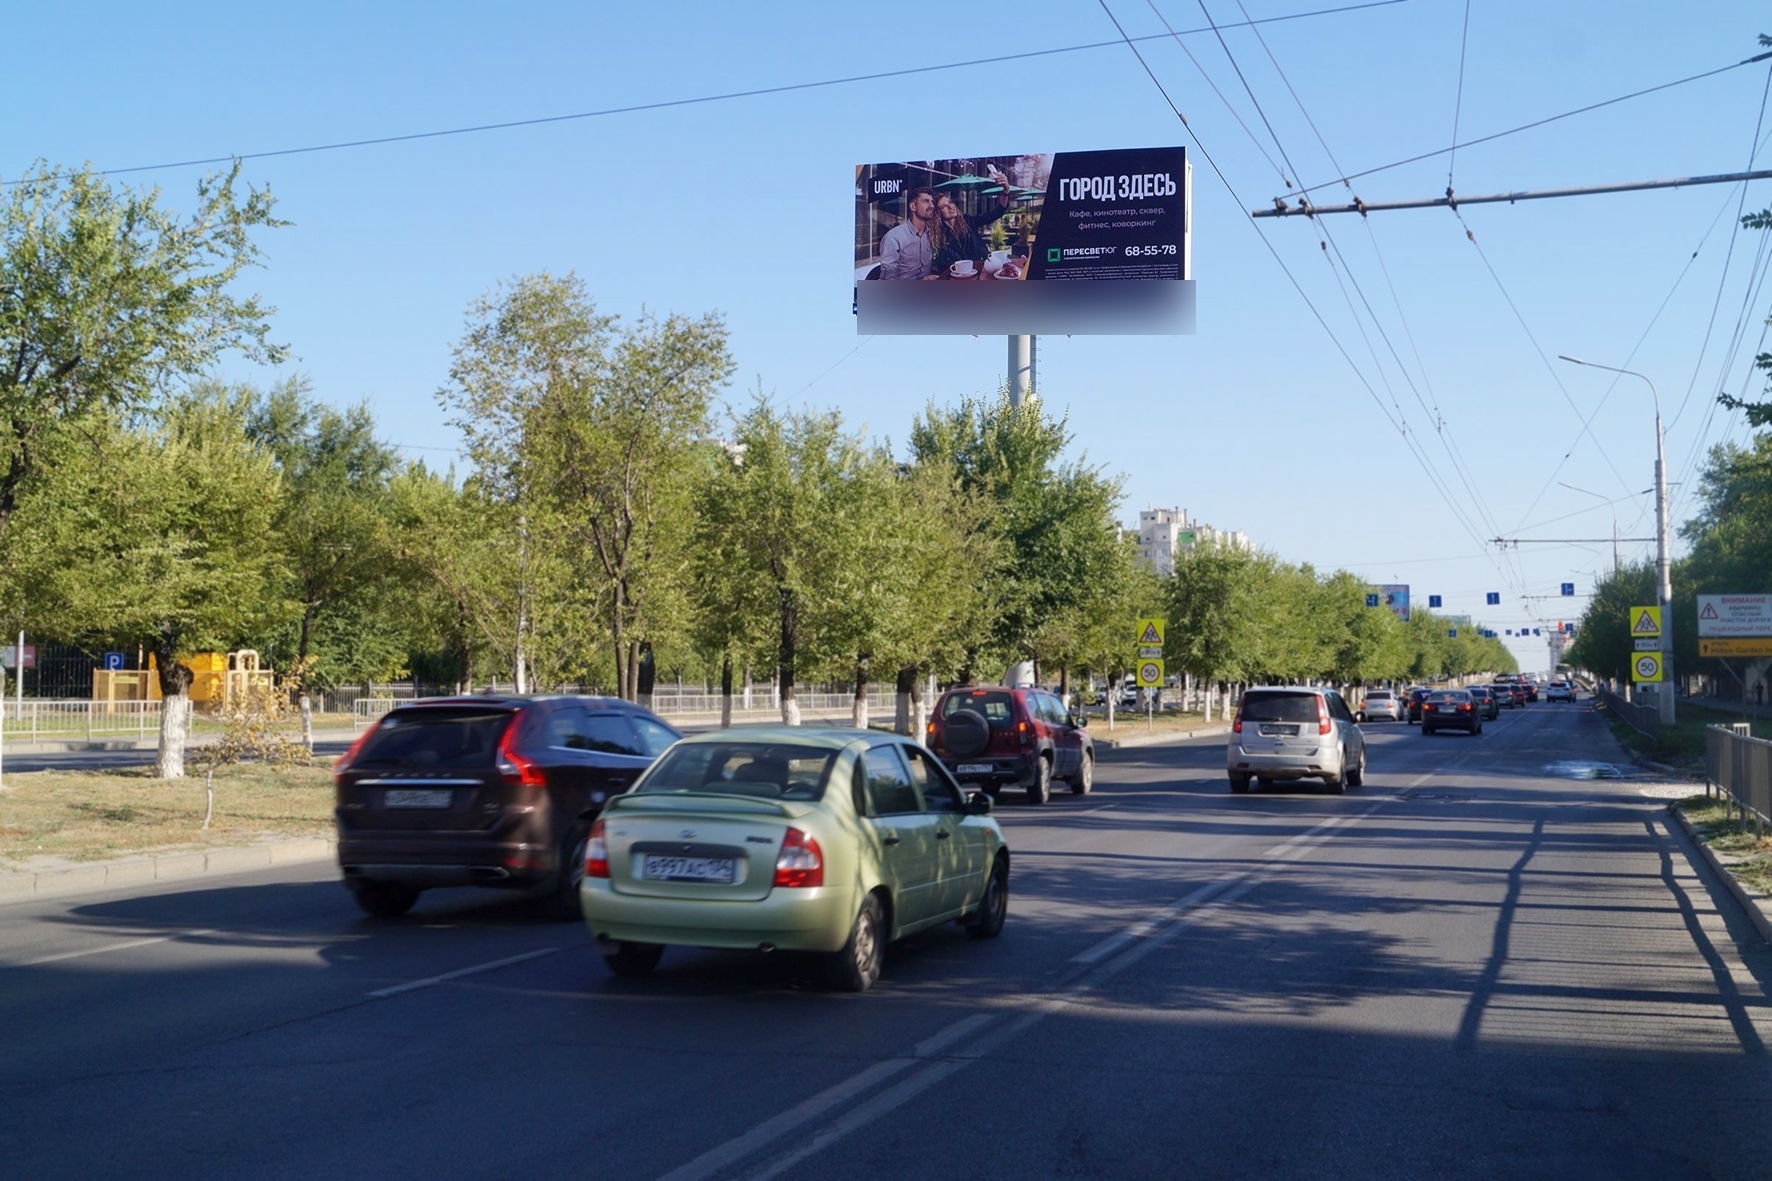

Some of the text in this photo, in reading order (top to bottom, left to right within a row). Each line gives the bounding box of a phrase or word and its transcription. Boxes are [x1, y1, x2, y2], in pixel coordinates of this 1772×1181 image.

[1060, 173, 1177, 202] ГОРОД ЗДЕСЬ
[1069, 206, 1166, 218] Кафе, кинотеатр, сквер,
[1078, 219, 1157, 230] фитнес, коворкинг
[1124, 244, 1177, 257] 68-55-78
[110, 655, 119, 670] P
[1641, 662, 1654, 672] 50
[1144, 668, 1156, 678] 50
